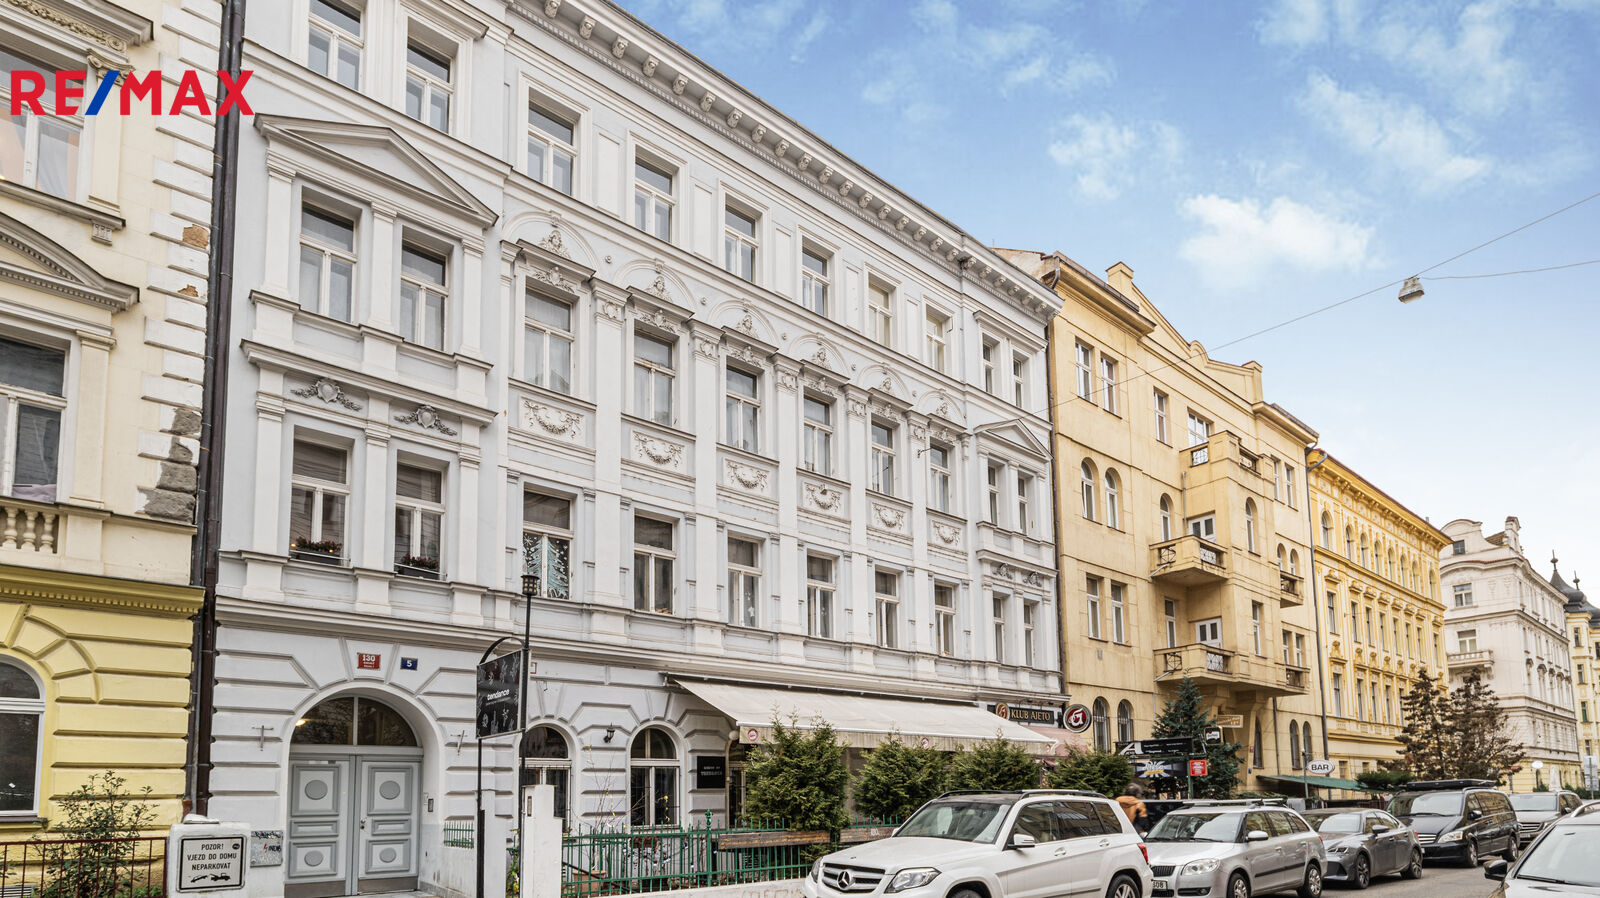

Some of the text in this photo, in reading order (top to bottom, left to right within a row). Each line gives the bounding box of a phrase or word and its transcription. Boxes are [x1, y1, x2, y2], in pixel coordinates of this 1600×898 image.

[362, 654, 376, 662] 130
[1011, 710, 1029, 719] KLUB
[1030, 711, 1051, 721] AJETO
[1311, 763, 1329, 771] BAR
[201, 843, 224, 851] POZOR!
[219, 852, 237, 860] DOMU
[191, 862, 231, 871] NEPARKOVAT
